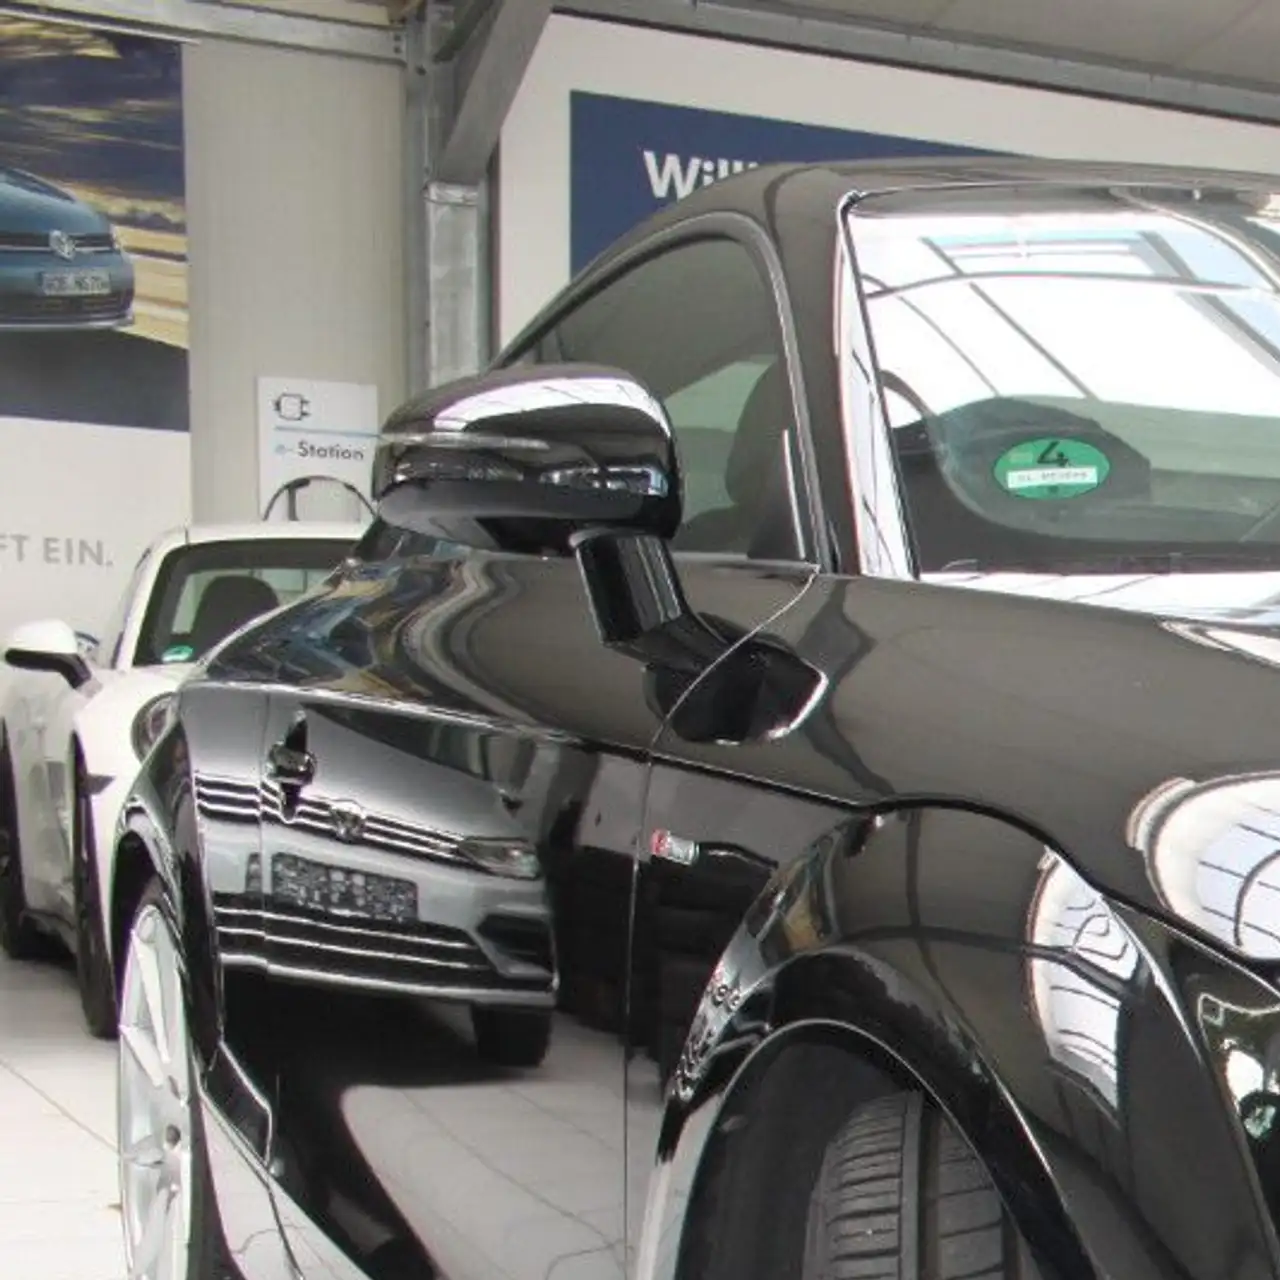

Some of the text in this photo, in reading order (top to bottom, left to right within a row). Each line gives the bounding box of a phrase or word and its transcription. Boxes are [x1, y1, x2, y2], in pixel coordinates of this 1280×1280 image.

[298, 441, 364, 460] Station
[1037, 441, 1069, 468] 4
[43, 537, 114, 567] EIN.
